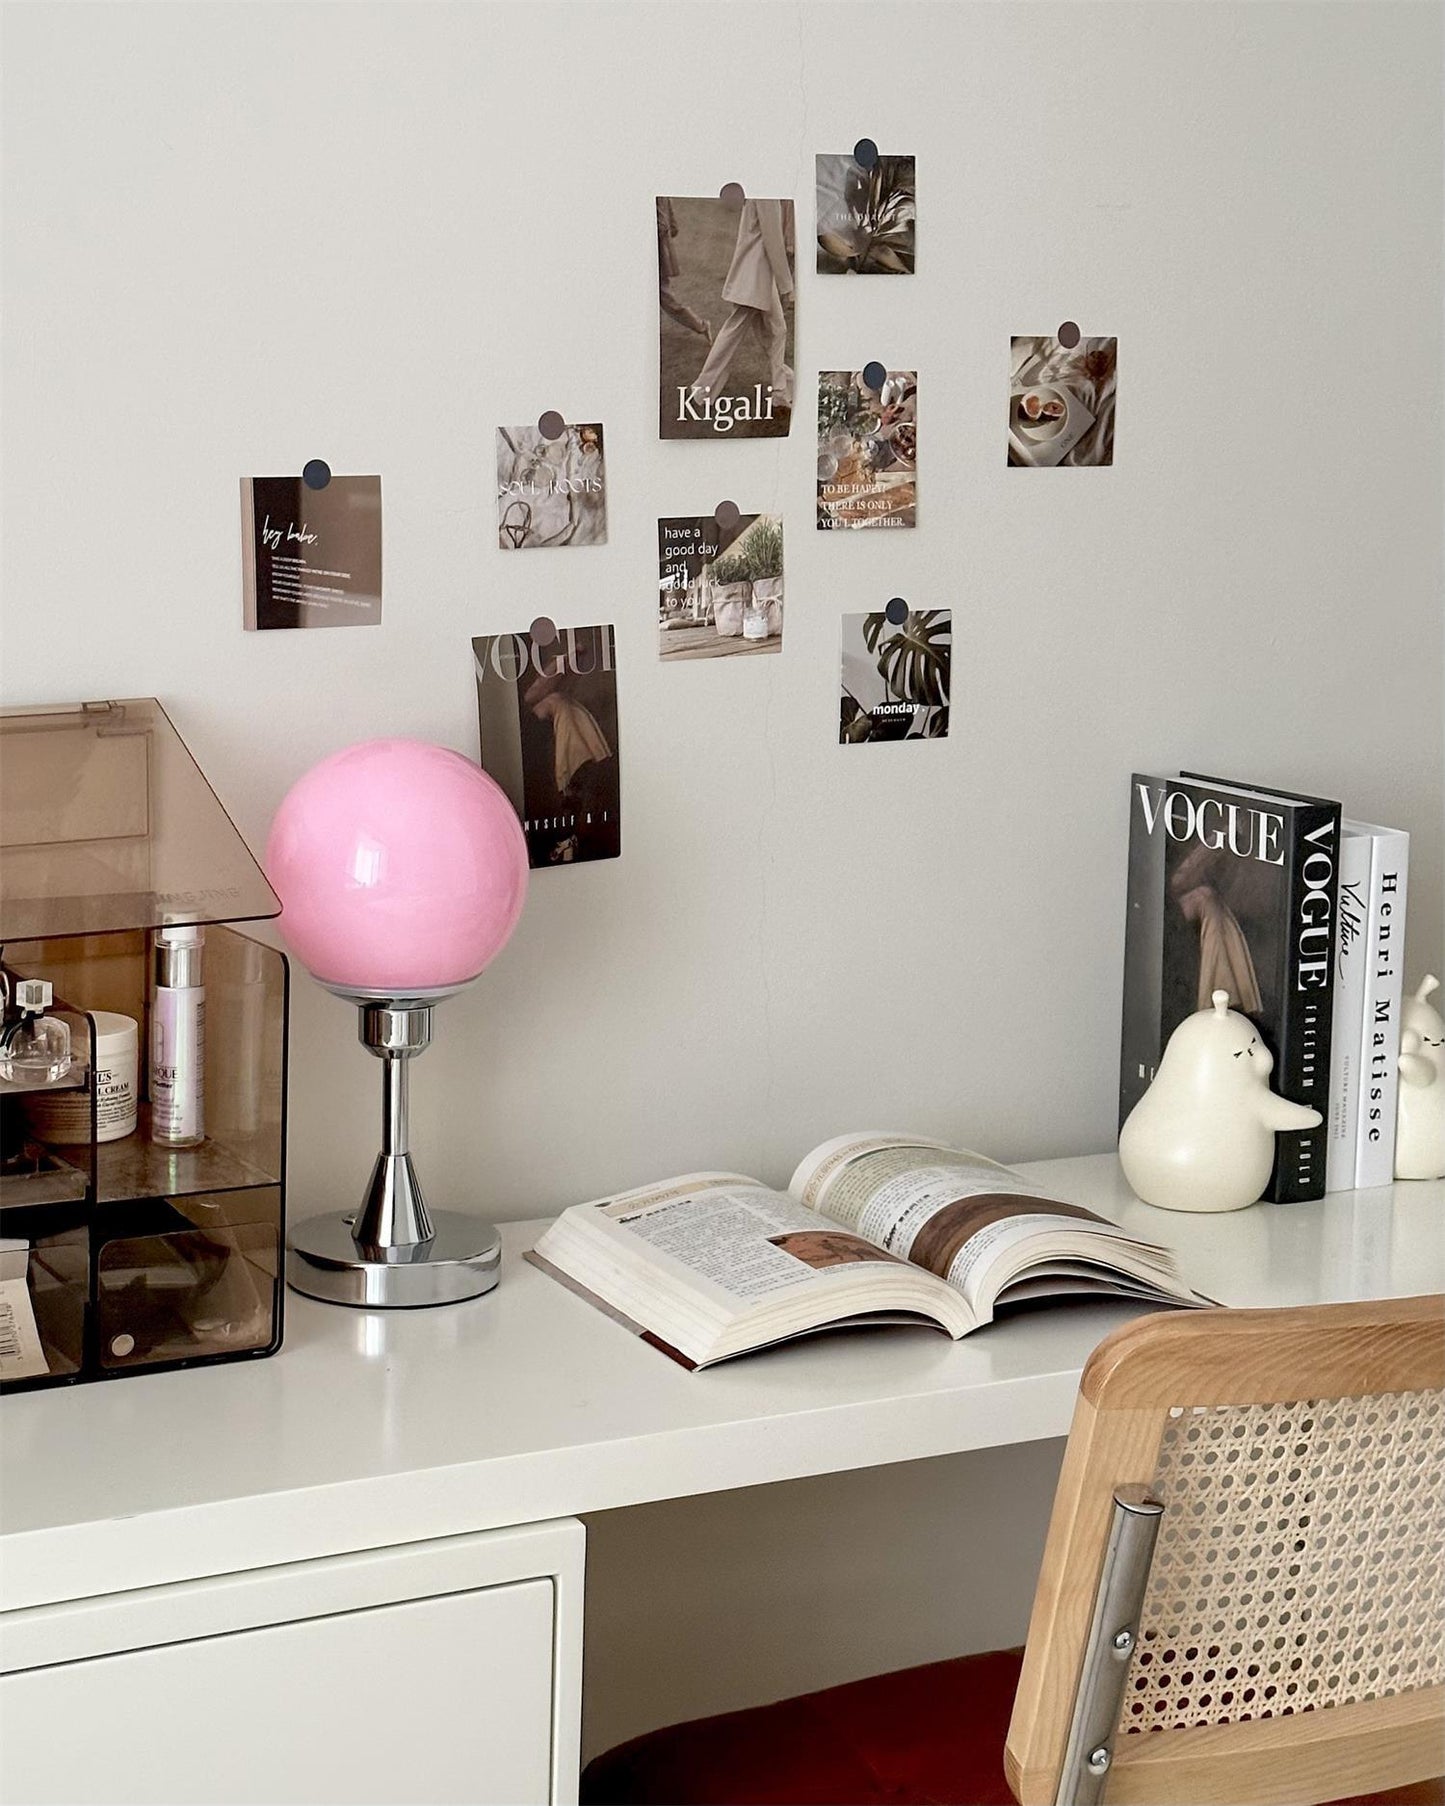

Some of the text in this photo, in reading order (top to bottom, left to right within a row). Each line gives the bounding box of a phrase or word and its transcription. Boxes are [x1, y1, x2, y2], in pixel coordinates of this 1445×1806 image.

[676, 383, 774, 432] Kigali
[549, 478, 603, 495] ROOTS
[821, 484, 835, 494] TO
[837, 484, 850, 494] BE
[821, 500, 894, 511] THERE IS ONLY
[262, 514, 284, 550] hey
[664, 526, 701, 539] have a
[665, 541, 719, 560] good day
[665, 560, 687, 573] and
[666, 597, 678, 608] to
[524, 814, 575, 832] MYSELF
[1135, 783, 1285, 866] VOGUE
[1297, 817, 1335, 991] VOGUE
[1377, 871, 1398, 978] Henri
[1302, 1005, 1318, 1088] FREEDOM
[1368, 998, 1391, 1143] Matisse
[1298, 1139, 1312, 1184] HOLD
